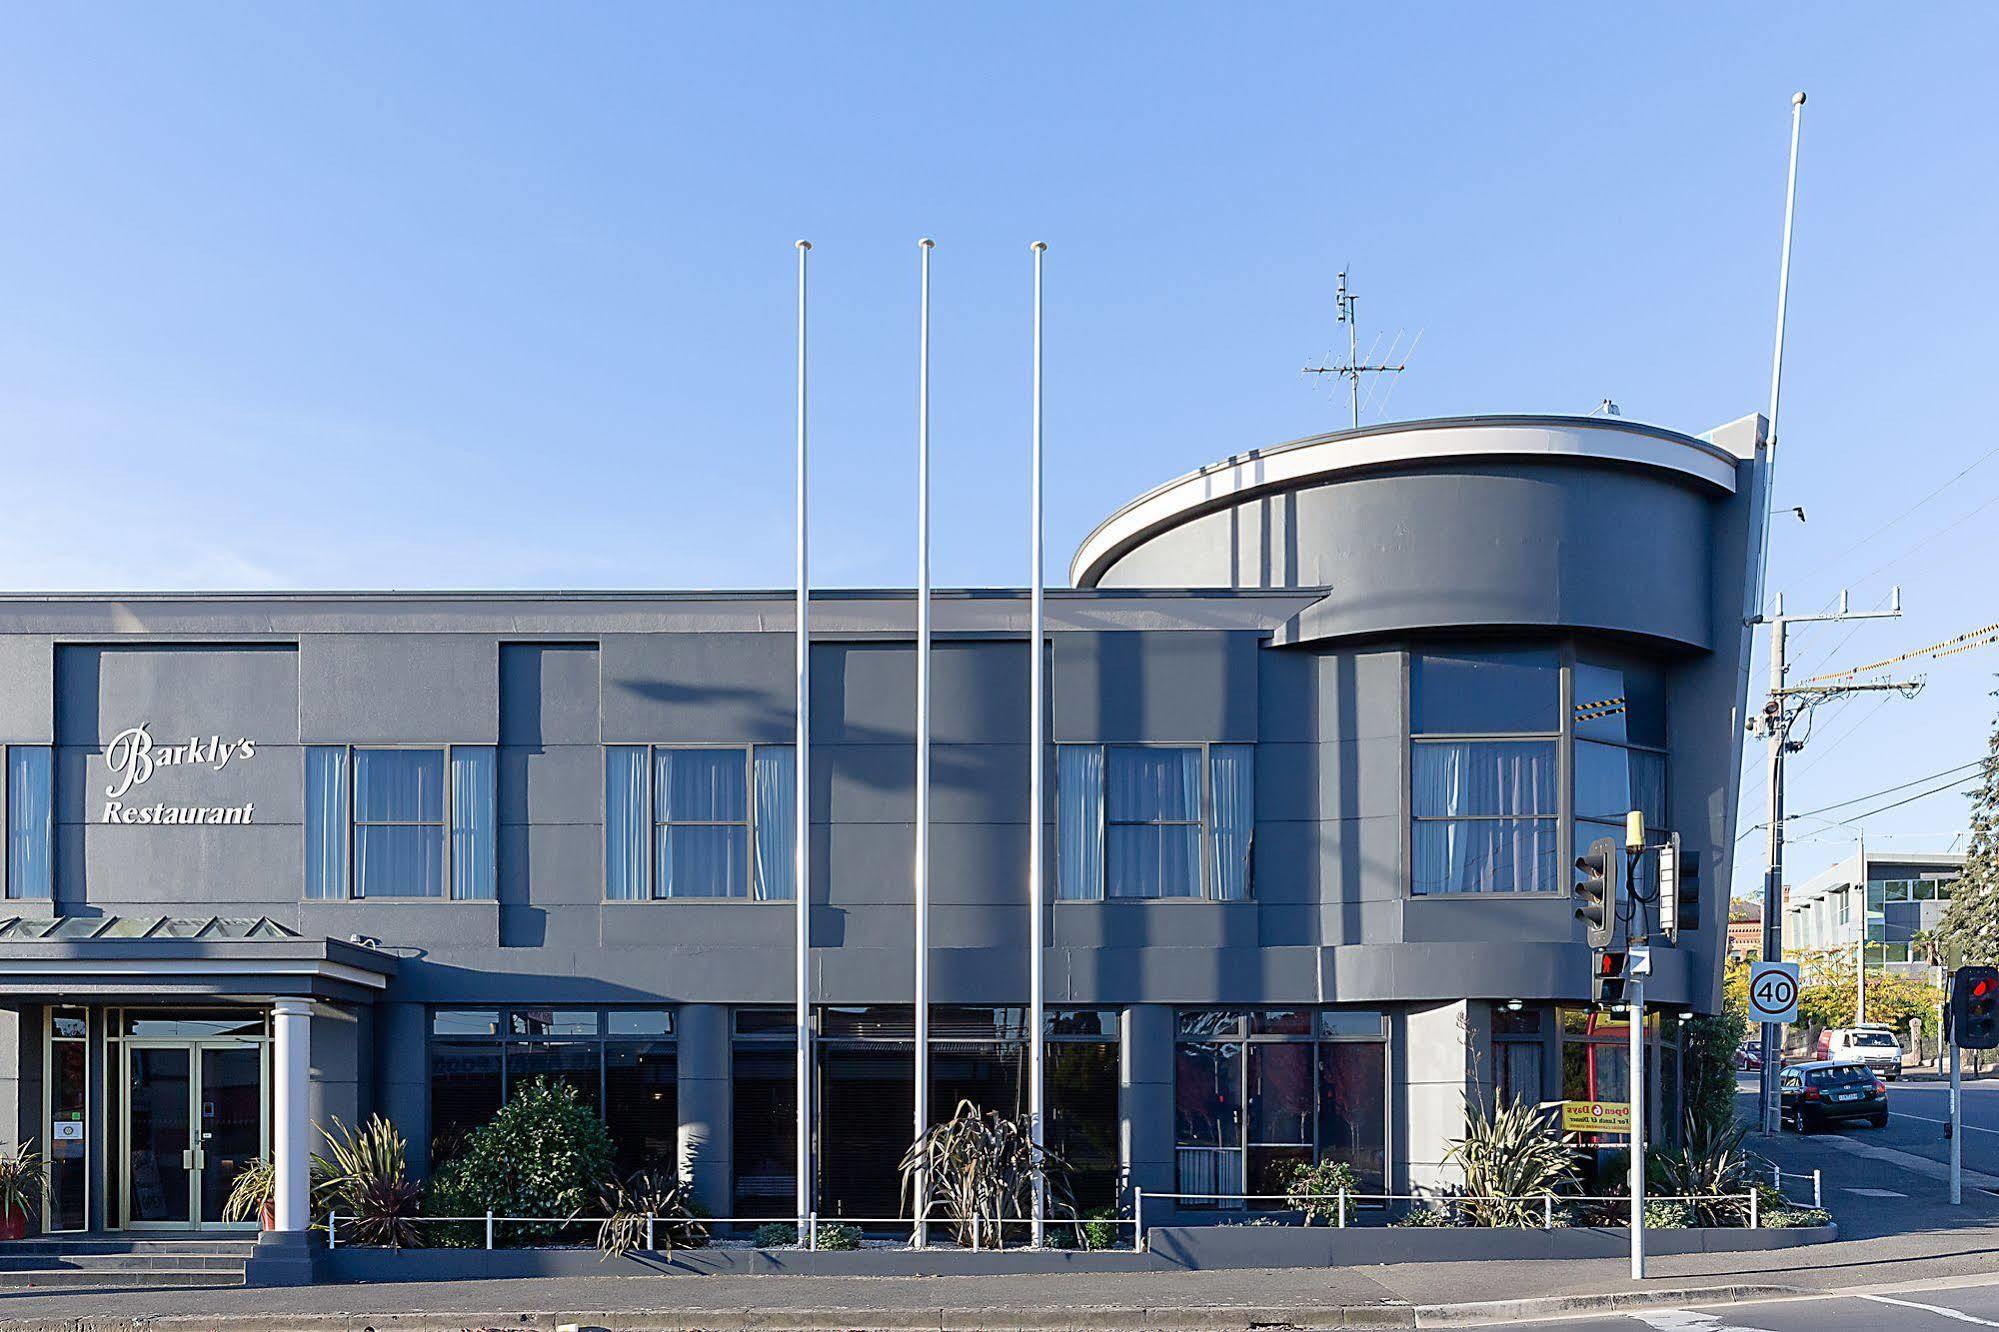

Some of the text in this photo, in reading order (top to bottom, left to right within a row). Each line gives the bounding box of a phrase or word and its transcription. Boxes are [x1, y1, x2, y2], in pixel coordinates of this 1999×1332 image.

[105, 721, 256, 798] Barkly's
[101, 801, 255, 825] Restaurant
[1757, 982, 1791, 1003] 40
